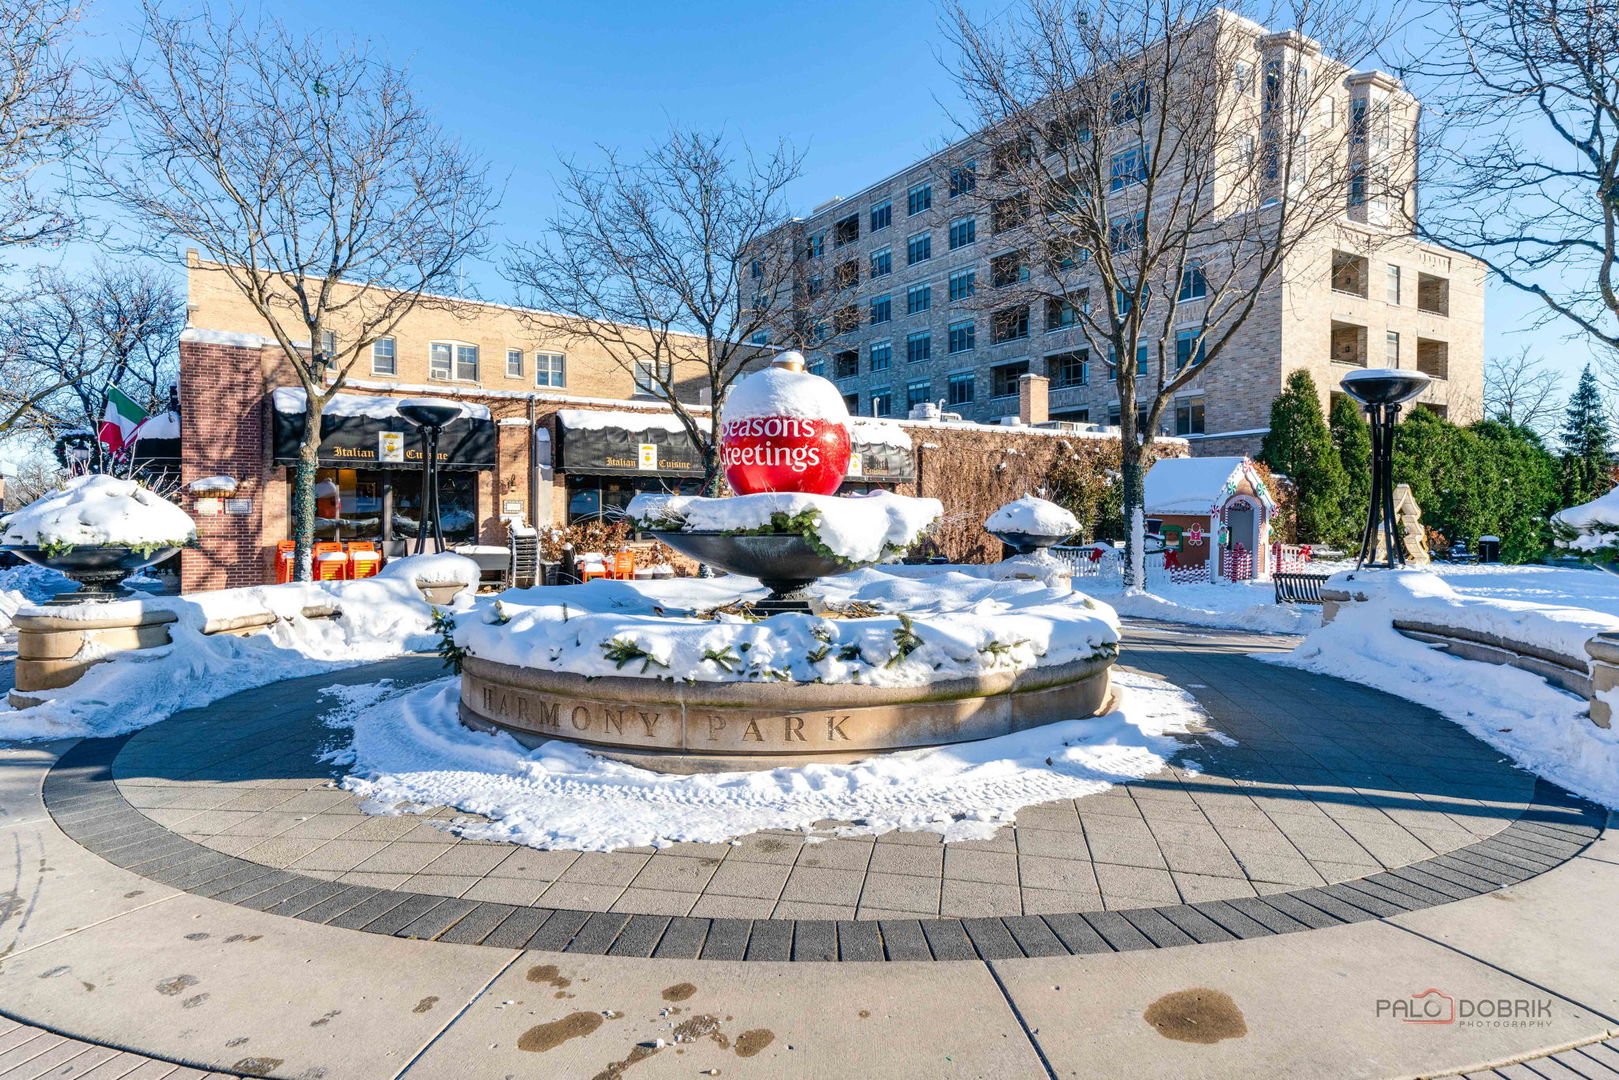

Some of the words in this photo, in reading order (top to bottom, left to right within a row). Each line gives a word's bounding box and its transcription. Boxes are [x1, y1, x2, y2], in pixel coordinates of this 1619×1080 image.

[333, 446, 375, 458] Italian
[405, 449, 449, 460] Cusne
[606, 456, 636, 467] Italian
[658, 459, 691, 469] Cuisine
[720, 441, 820, 473] Greetings
[482, 687, 661, 738] HARMONY
[708, 714, 851, 742] PARK
